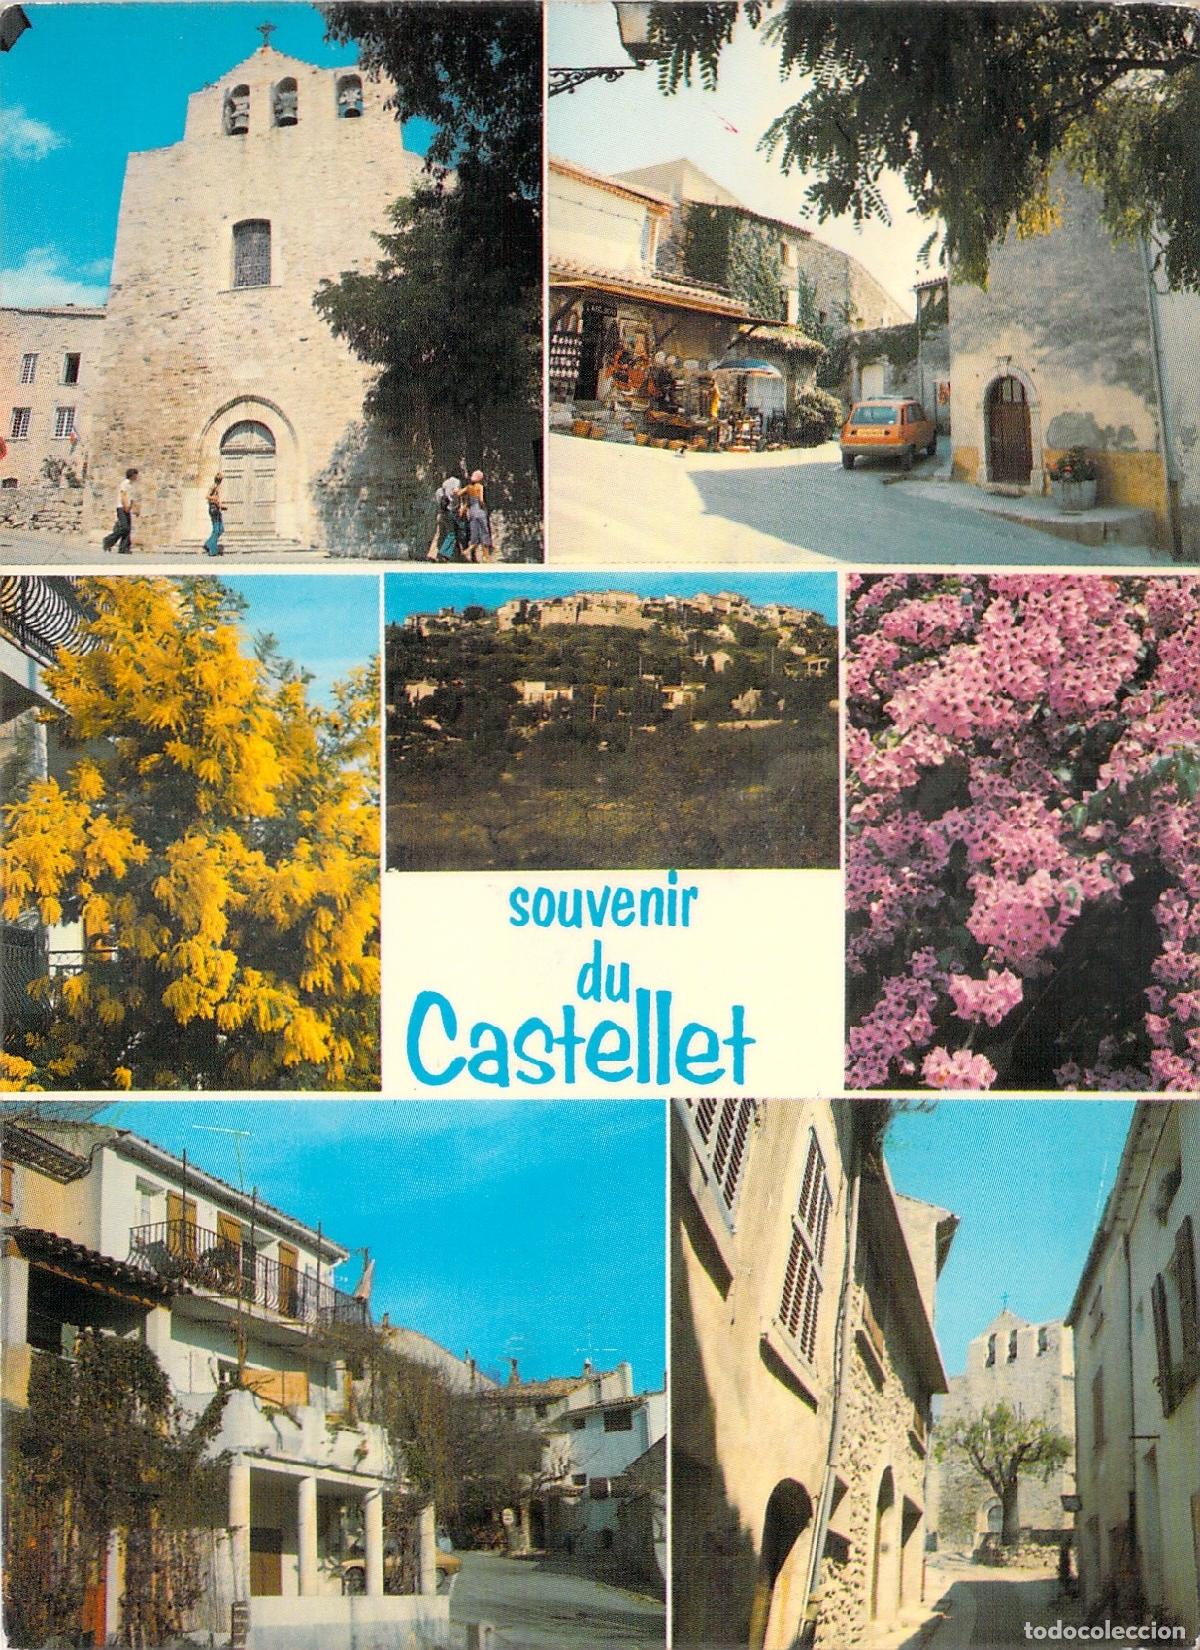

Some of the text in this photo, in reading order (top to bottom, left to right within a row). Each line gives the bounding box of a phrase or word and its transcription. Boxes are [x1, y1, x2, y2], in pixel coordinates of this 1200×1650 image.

[509, 869, 699, 928] souvenir
[577, 940, 631, 1003] du
[407, 987, 756, 1088] Castellet
